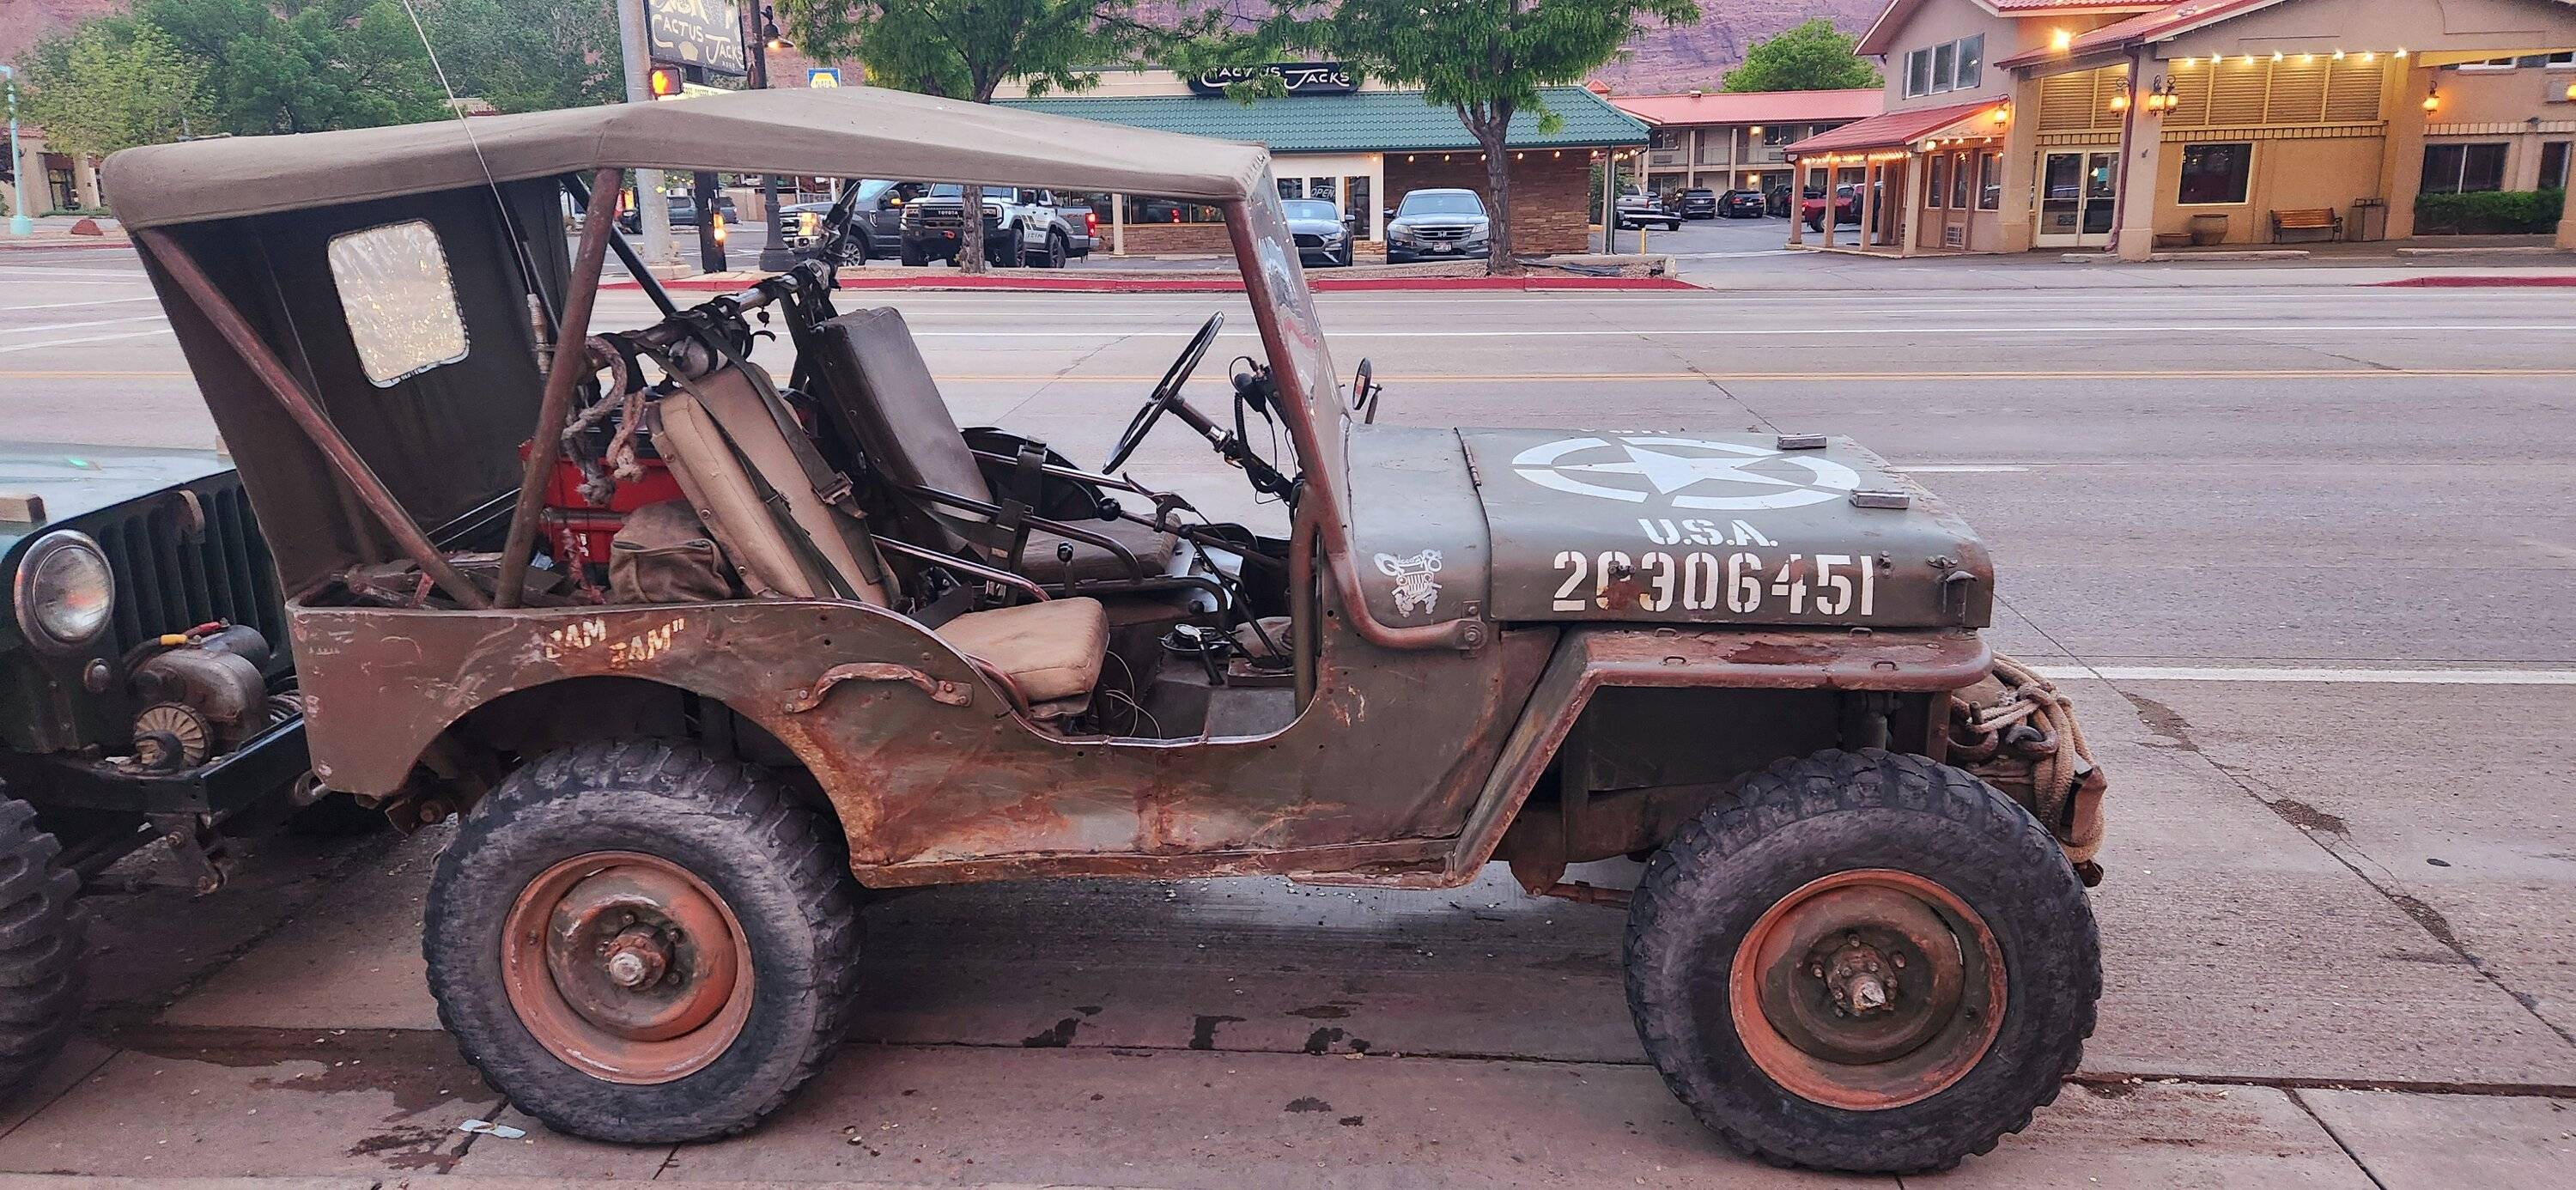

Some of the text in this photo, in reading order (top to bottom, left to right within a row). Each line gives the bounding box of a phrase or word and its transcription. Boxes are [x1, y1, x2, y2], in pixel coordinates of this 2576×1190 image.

[652, 14, 744, 70] CACTUS JACKS
[1284, 69, 1351, 89] JACKS
[1310, 188, 1334, 197] OPEN
[1637, 519, 1778, 547] U.S.A.
